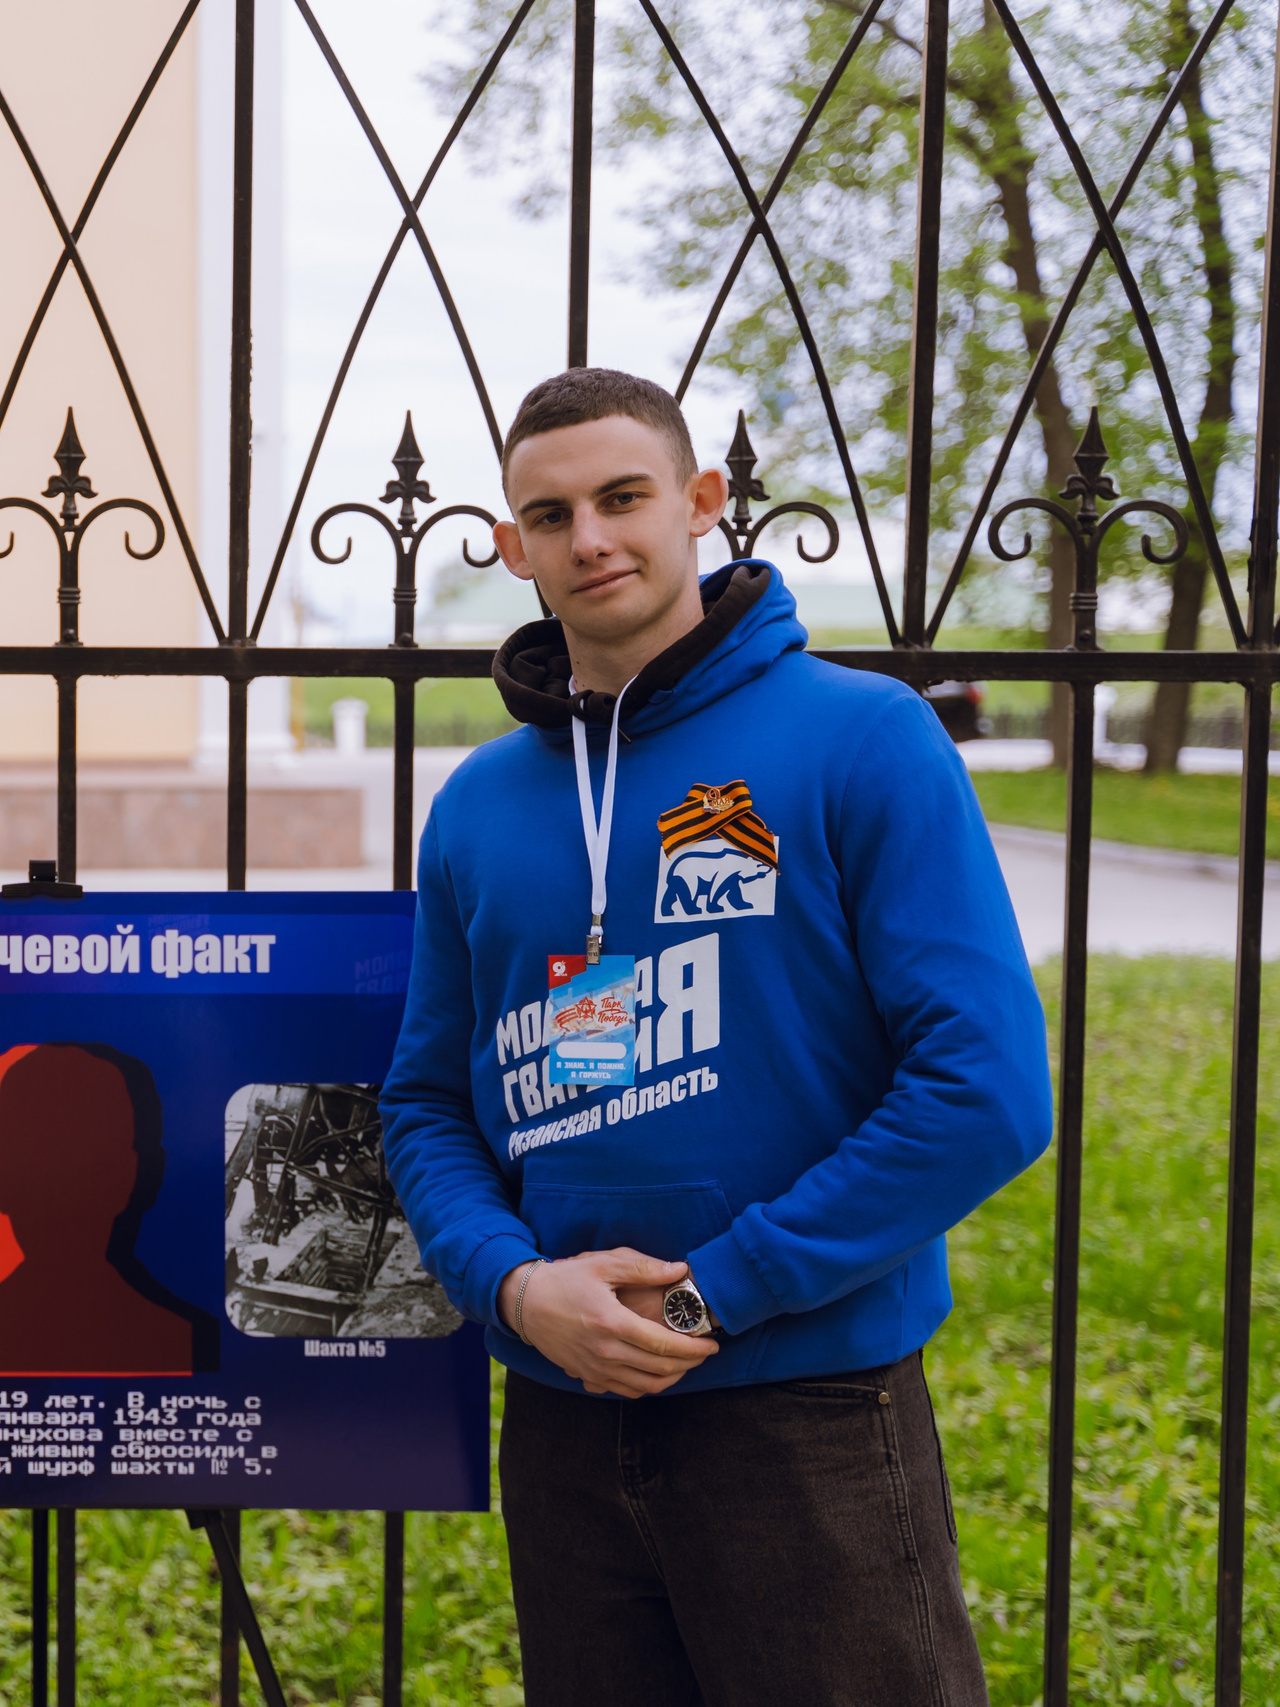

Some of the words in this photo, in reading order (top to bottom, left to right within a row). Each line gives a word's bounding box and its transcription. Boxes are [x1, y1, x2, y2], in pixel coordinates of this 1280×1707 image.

[151, 929, 277, 979] факт
[601, 997, 625, 1009] Парк
[556, 1061, 562, 1069] Я
[508, 1104, 602, 1161] Рязанская
[606, 1066, 719, 1126] область
[304, 1340, 356, 1357] Шахта
[358, 1340, 386, 1358] №5
[44, 1395, 105, 1409] лет.
[127, 1391, 144, 1409] В
[161, 1396, 228, 1409] ночь
[244, 1396, 261, 1409] с
[113, 1408, 178, 1425] 1943
[196, 1412, 261, 1427] года
[119, 1428, 220, 1442] вместе
[236, 1429, 253, 1442] с
[11, 1444, 95, 1458] живым
[111, 1441, 245, 1460] сбросили
[261, 1445, 278, 1459] в
[28, 1459, 95, 1476] шурф
[111, 1461, 195, 1475] шахты
[211, 1457, 228, 1475] №
[244, 1458, 272, 1475] 5.
